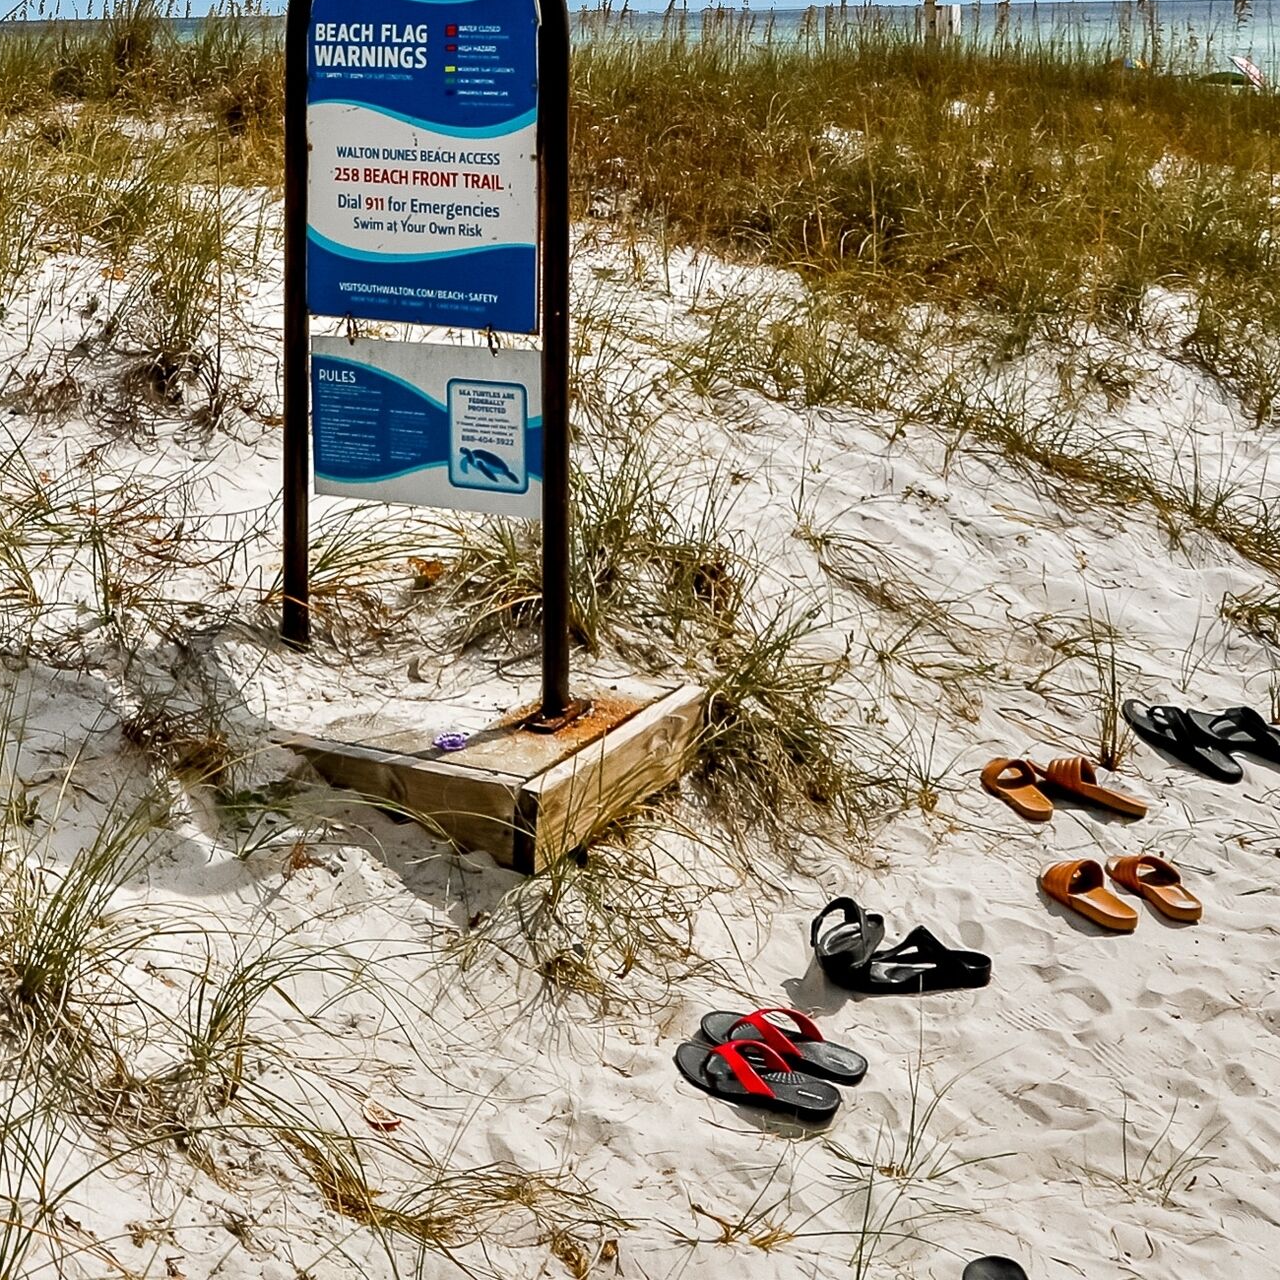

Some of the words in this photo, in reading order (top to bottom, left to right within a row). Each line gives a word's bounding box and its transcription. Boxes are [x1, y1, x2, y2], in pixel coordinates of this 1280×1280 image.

[315, 24, 376, 42] BEACH
[381, 25, 427, 43] FLAG
[315, 45, 427, 69] WARNINGS
[337, 146, 380, 160] WALTON
[383, 149, 417, 161] DUNES
[420, 151, 455, 163] BEACH
[459, 152, 500, 165] ACCESS
[334, 168, 359, 182] 258
[364, 169, 408, 185] BEACH
[412, 170, 457, 187] FRONT
[463, 173, 504, 190] TRAIL
[338, 194, 362, 210] Dial
[365, 197, 384, 211] 911
[388, 196, 407, 212] for
[410, 199, 500, 220] Emergencies
[354, 217, 383, 230] Swim
[387, 220, 397, 232] at
[401, 220, 425, 233] Your
[429, 222, 455, 235] Own
[459, 223, 482, 237] Risk
[319, 369, 355, 383] RULES
[468, 405, 506, 413] PROTECTED
